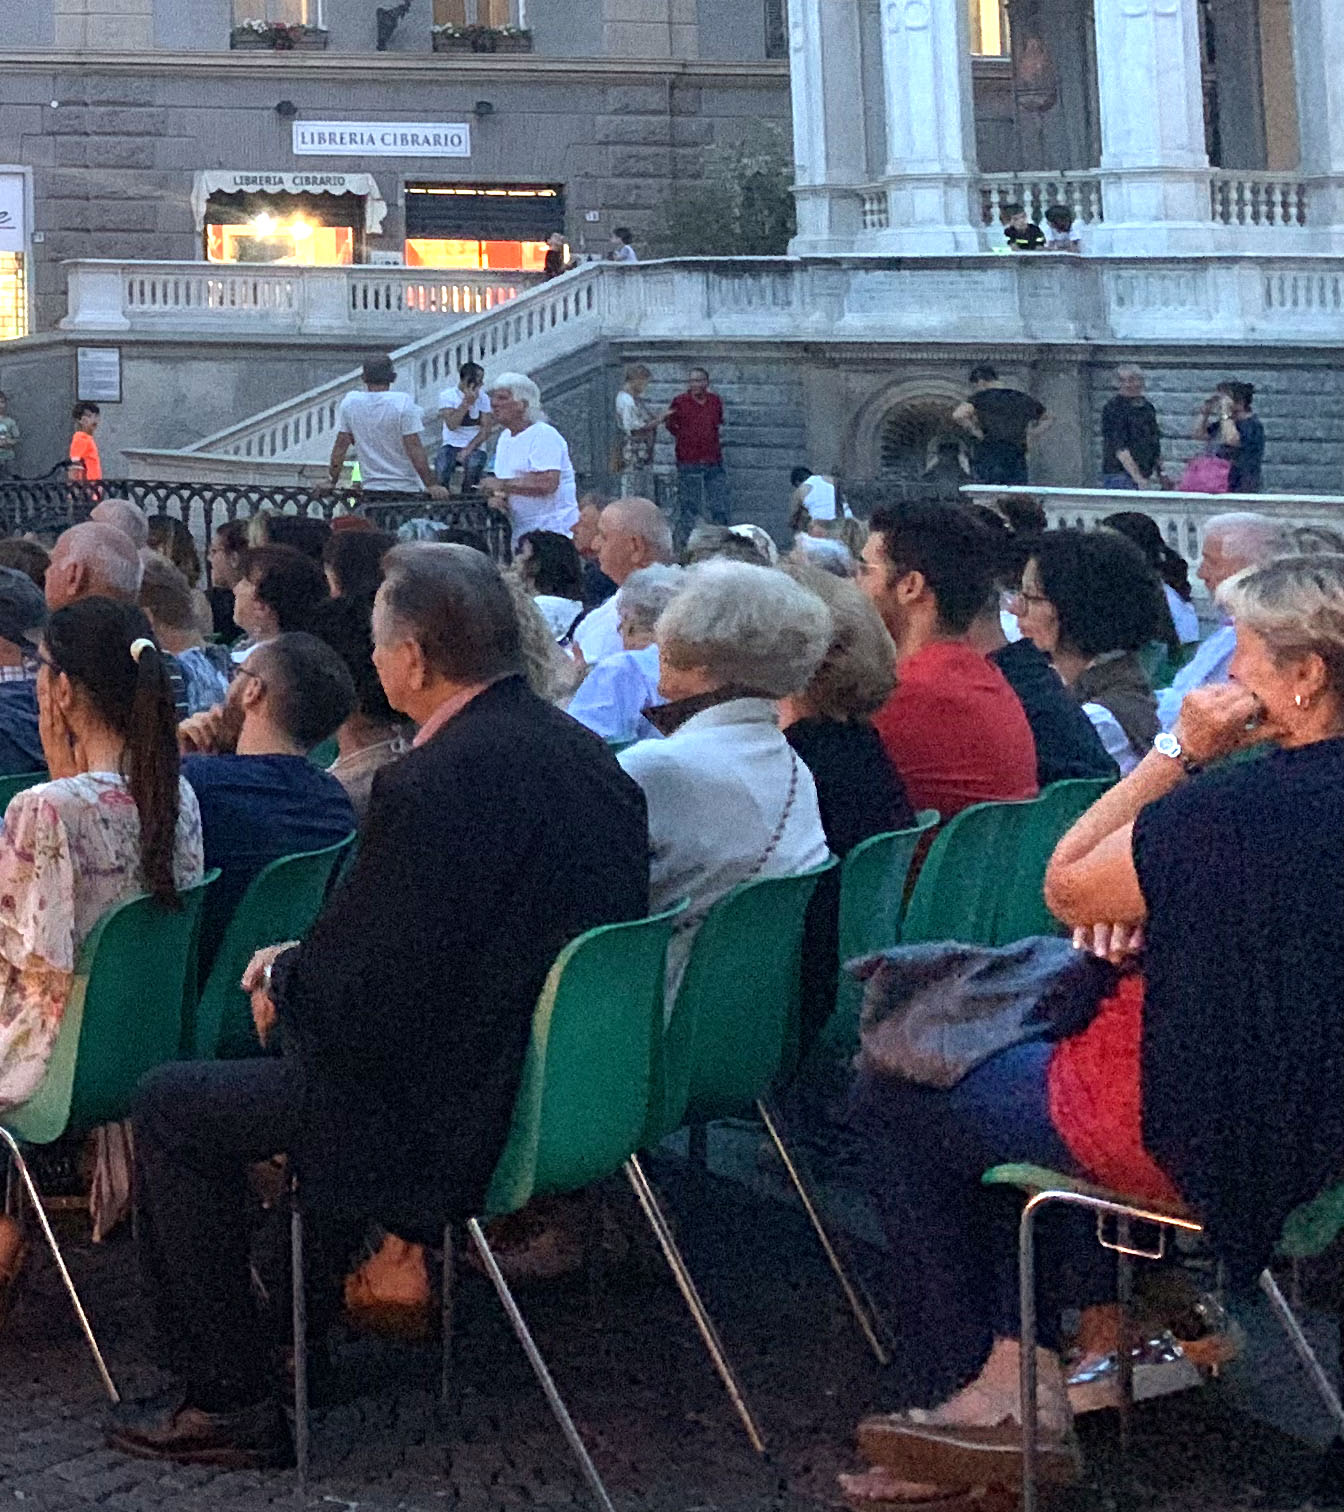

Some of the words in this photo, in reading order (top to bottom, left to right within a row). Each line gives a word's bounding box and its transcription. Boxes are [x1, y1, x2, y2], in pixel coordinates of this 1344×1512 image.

[300, 131, 376, 146] LIBRERIA
[380, 132, 463, 147] CIBRARIO
[233, 175, 285, 186] LIBRERIA
[292, 175, 346, 187] CIBRARIO
